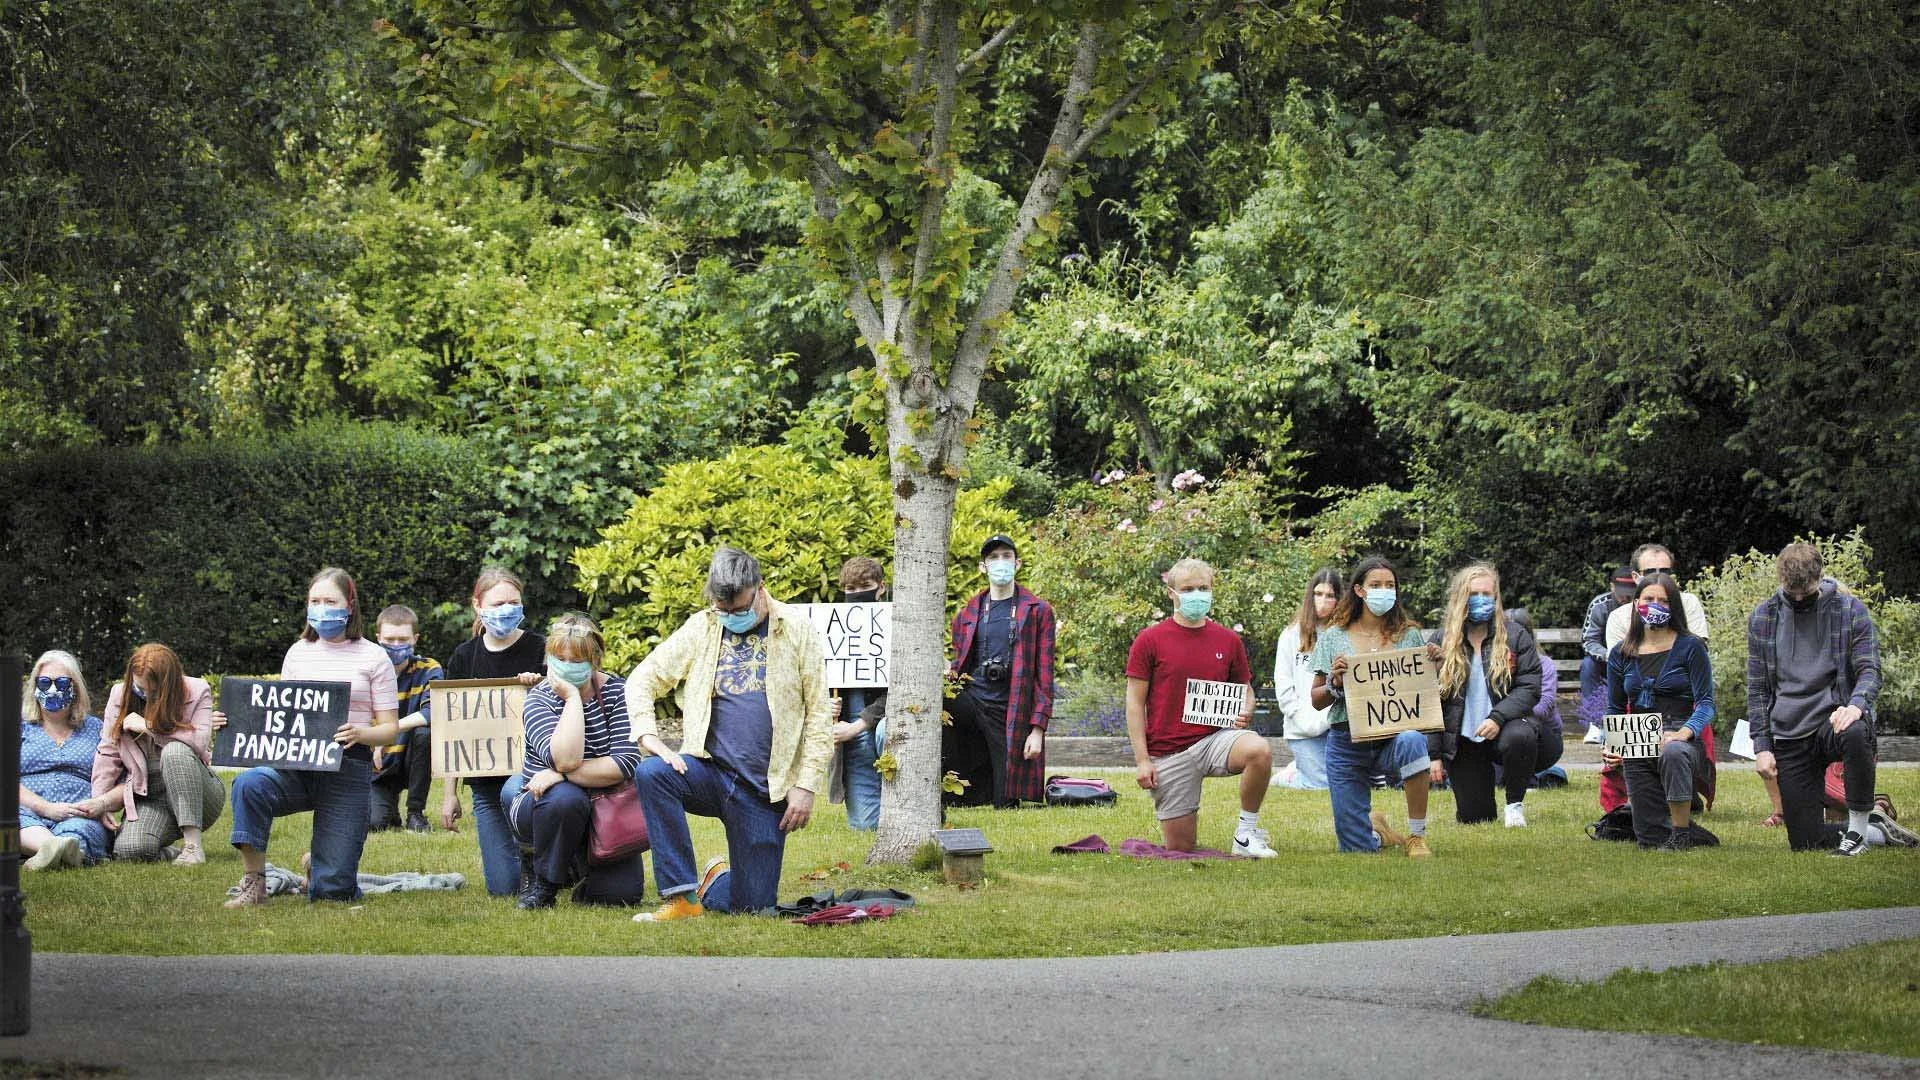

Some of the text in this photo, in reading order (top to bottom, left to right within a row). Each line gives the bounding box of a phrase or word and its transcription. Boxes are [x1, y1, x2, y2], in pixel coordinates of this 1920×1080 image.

[1353, 654, 1424, 683] CHANGE
[251, 683, 330, 713] RACISM
[1381, 680, 1396, 696] IS
[446, 688, 518, 722] BLACK
[1367, 693, 1420, 727] NOW
[264, 710, 306, 737] IS A
[1606, 716, 1646, 732] BLACK
[1625, 730, 1661, 745] LIVES
[232, 732, 340, 766] PANDEMIC
